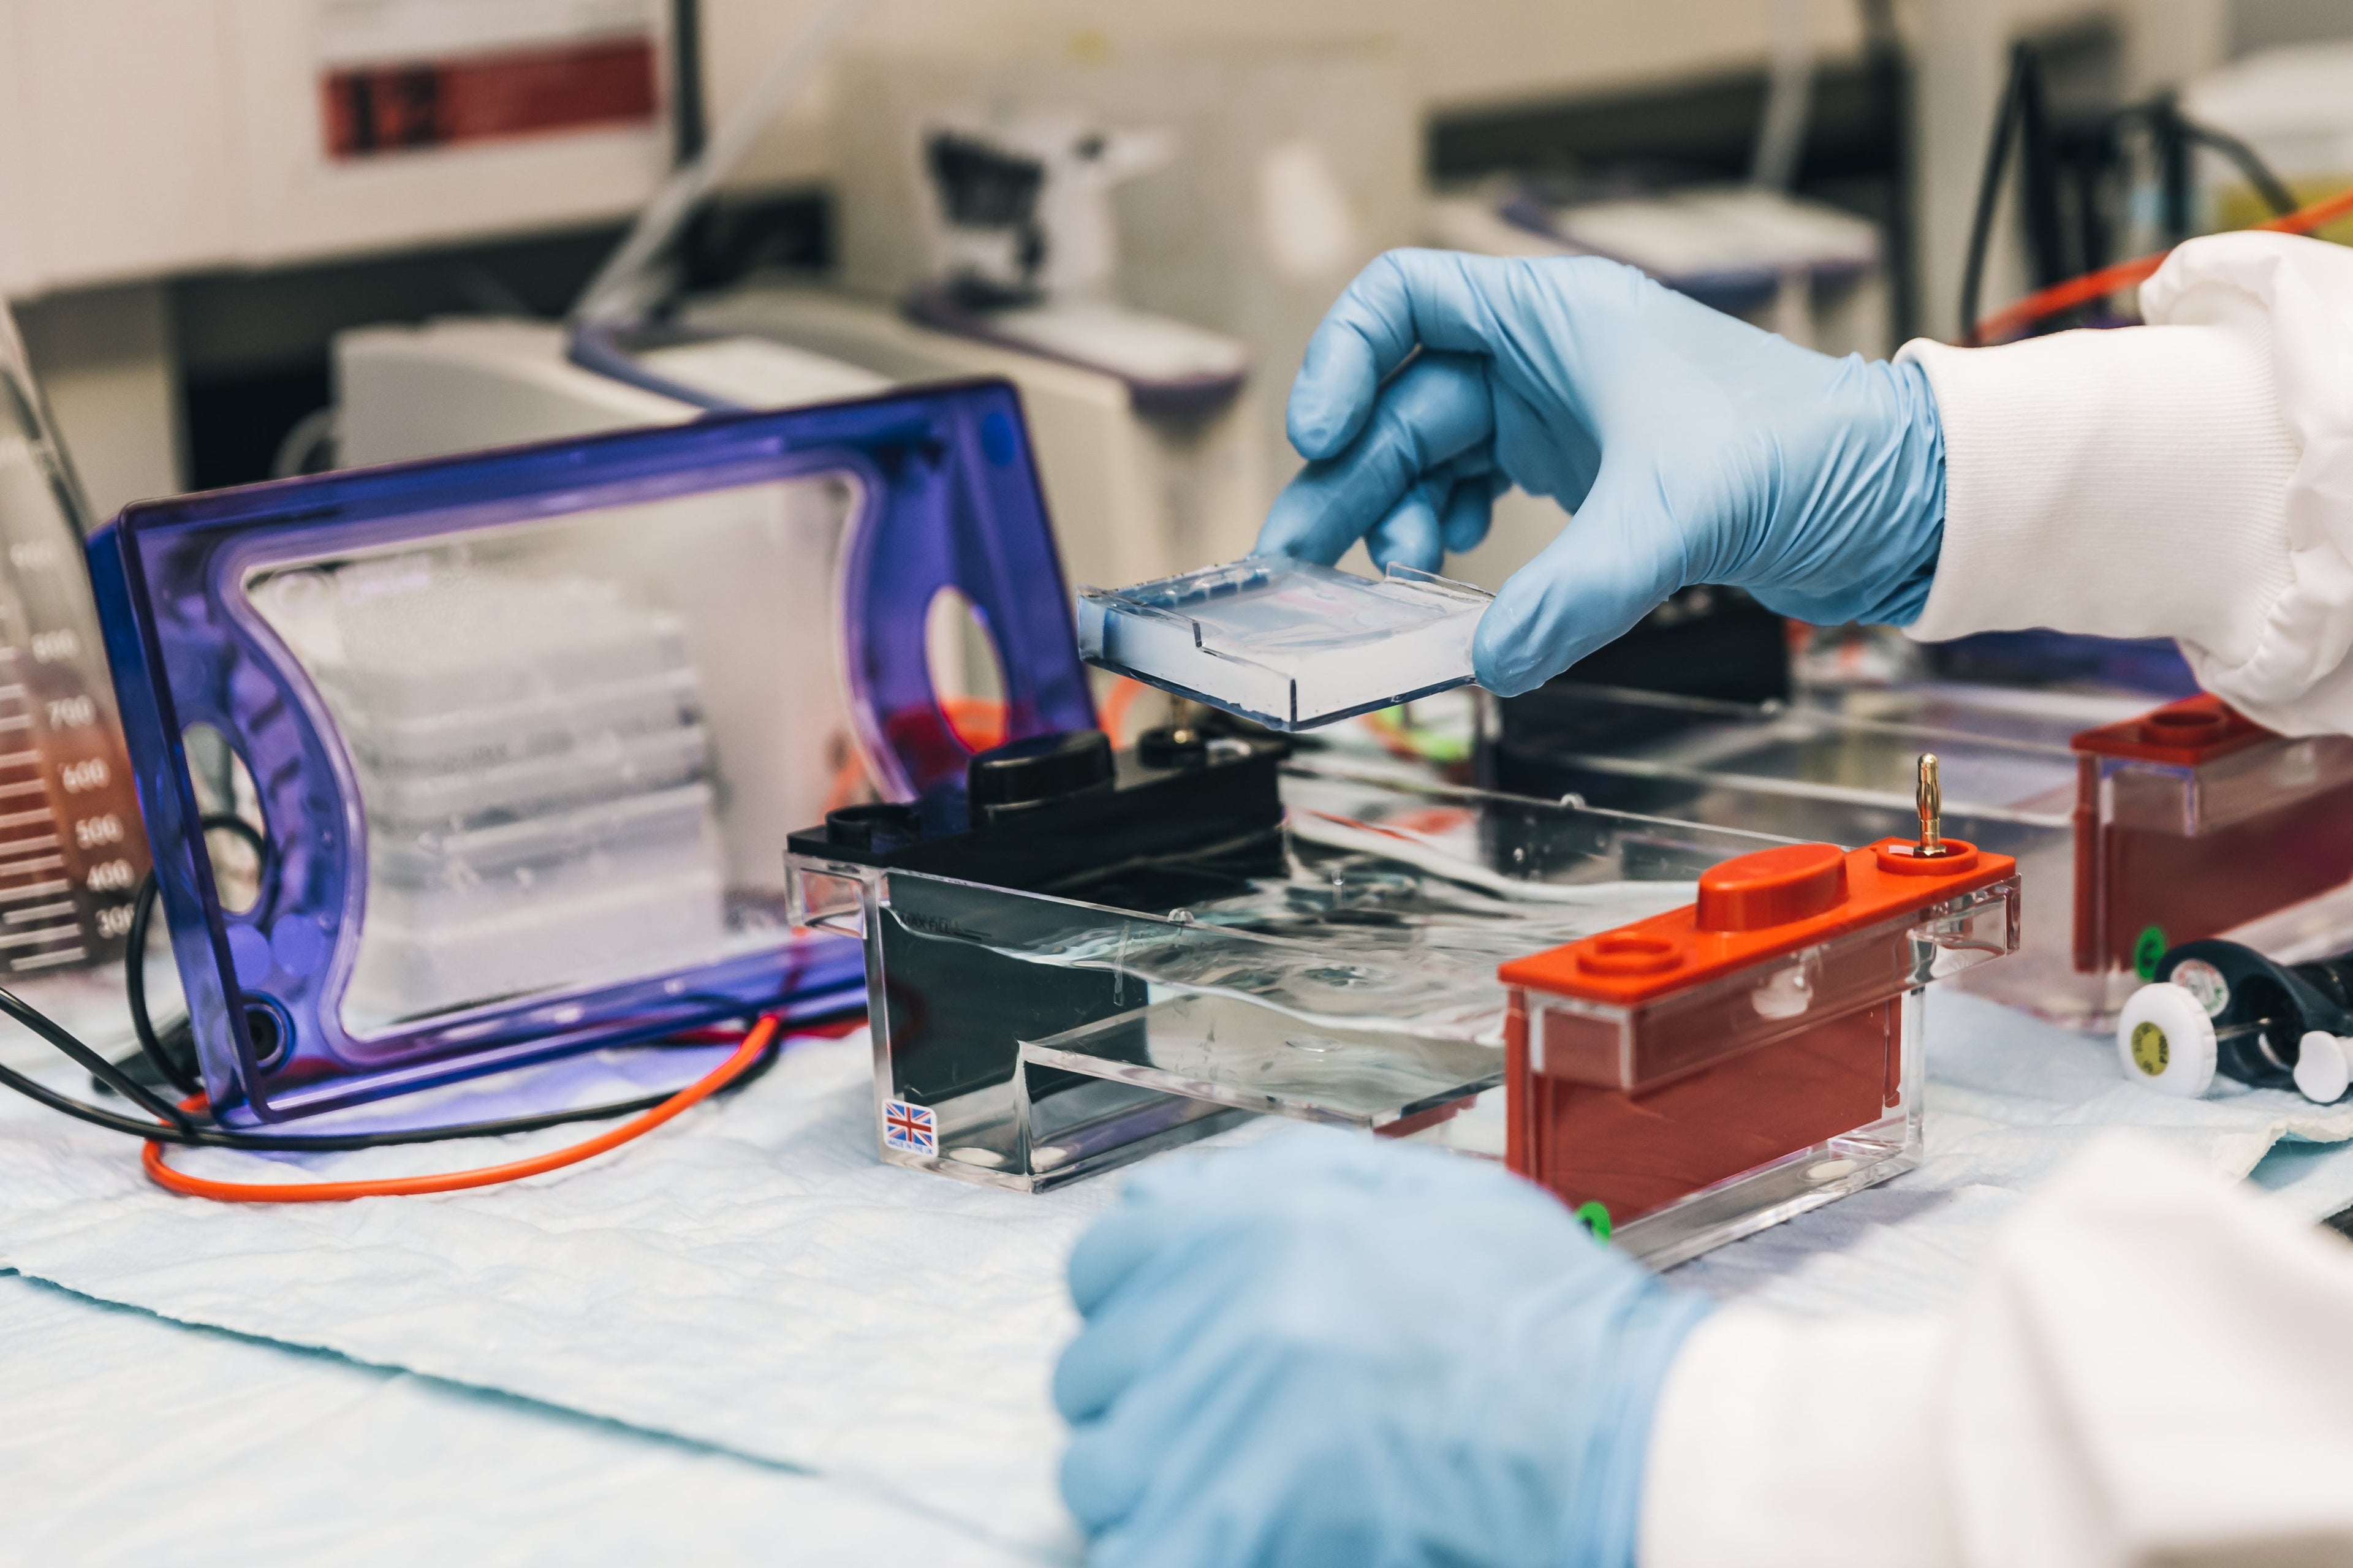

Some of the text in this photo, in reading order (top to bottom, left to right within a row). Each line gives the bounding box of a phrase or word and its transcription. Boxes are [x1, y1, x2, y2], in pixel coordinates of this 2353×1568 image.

[46, 695, 96, 730] 700
[63, 758, 110, 793] 600
[76, 814, 124, 849] 500
[87, 858, 135, 891] 400
